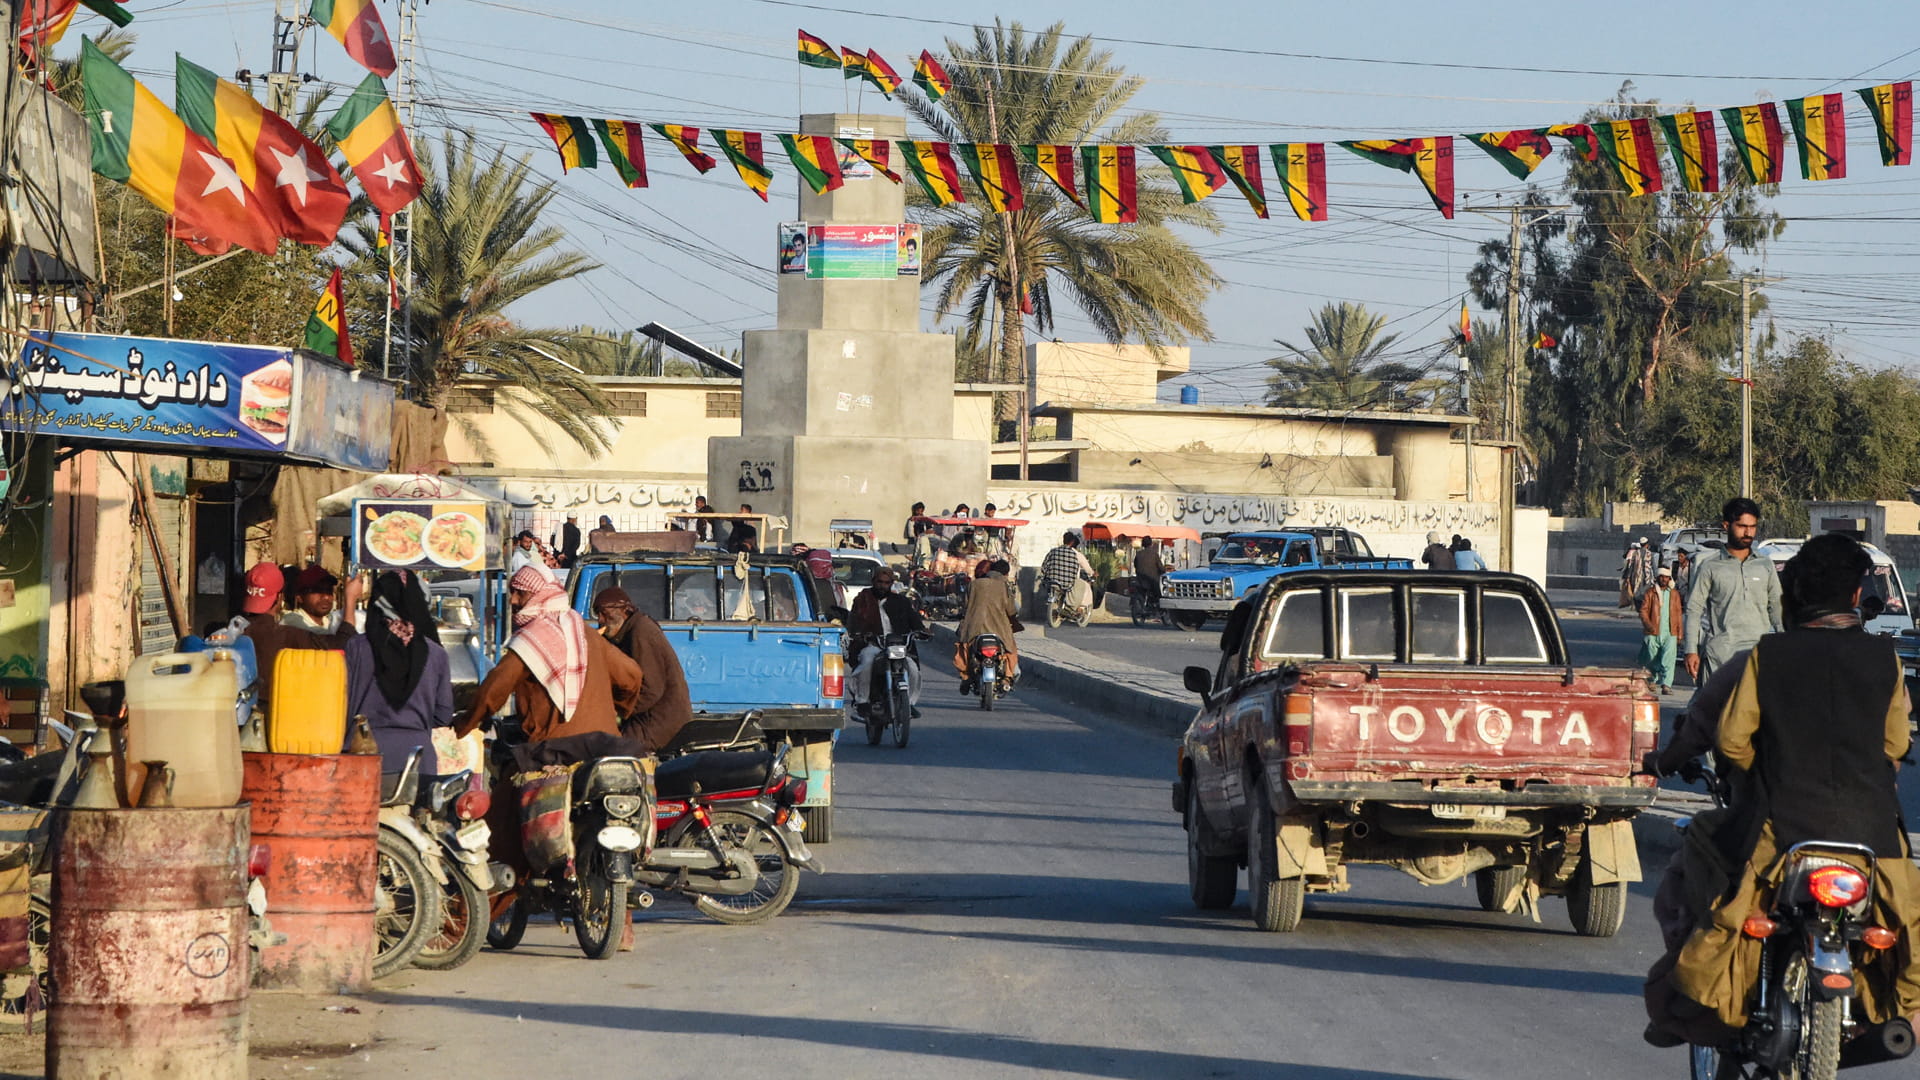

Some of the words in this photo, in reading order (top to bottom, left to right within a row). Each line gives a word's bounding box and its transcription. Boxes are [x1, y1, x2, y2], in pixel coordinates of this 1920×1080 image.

[123, 346, 178, 406] فوڈ
[178, 362, 229, 405] داد
[1349, 705, 1593, 746] TOYOTA
